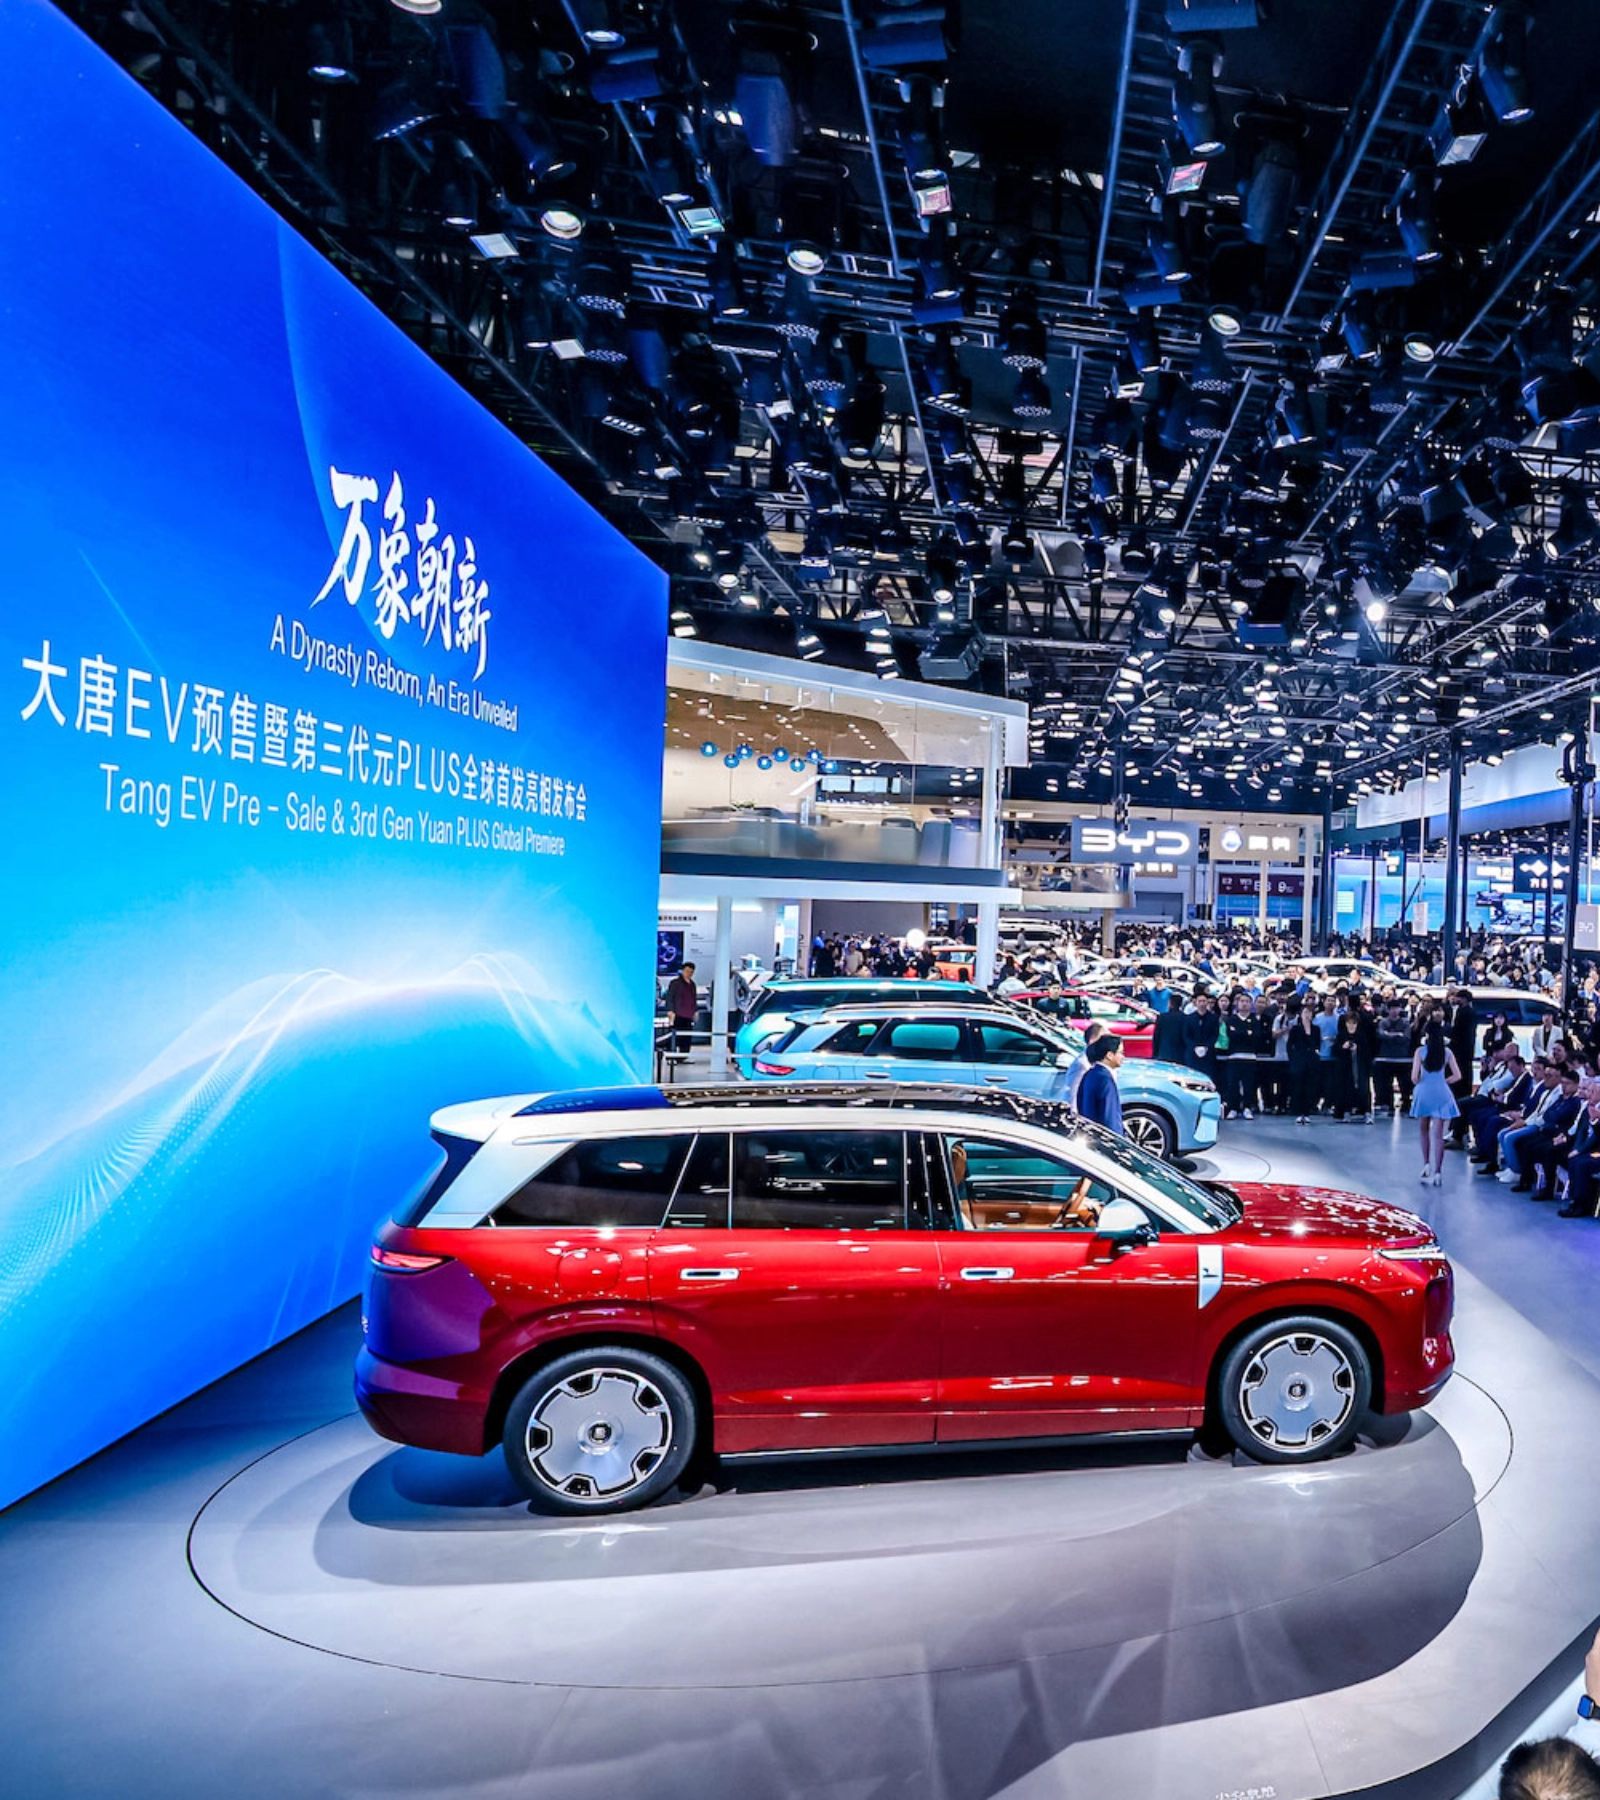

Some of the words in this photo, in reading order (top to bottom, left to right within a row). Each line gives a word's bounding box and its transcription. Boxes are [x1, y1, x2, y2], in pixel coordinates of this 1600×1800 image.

[309, 465, 491, 682] 万象朝新
[270, 614, 286, 654] A
[291, 620, 362, 687] Dynasty
[366, 650, 423, 707] Reborn,
[427, 674, 446, 708] An
[448, 680, 470, 716] Era
[473, 689, 518, 732] Unveiled
[100, 763, 171, 828] Tang
[181, 775, 216, 821] EV
[223, 782, 260, 826] Pre
[286, 791, 327, 833] Sale
[331, 798, 345, 834] &
[350, 801, 378, 838] 3rd
[382, 806, 414, 841] Gen
[418, 811, 453, 846] Yuan
[457, 816, 489, 849] PLUS
[492, 821, 524, 853] Global
[525, 826, 567, 856] Premiere
[1081, 827, 1190, 855] BYD
